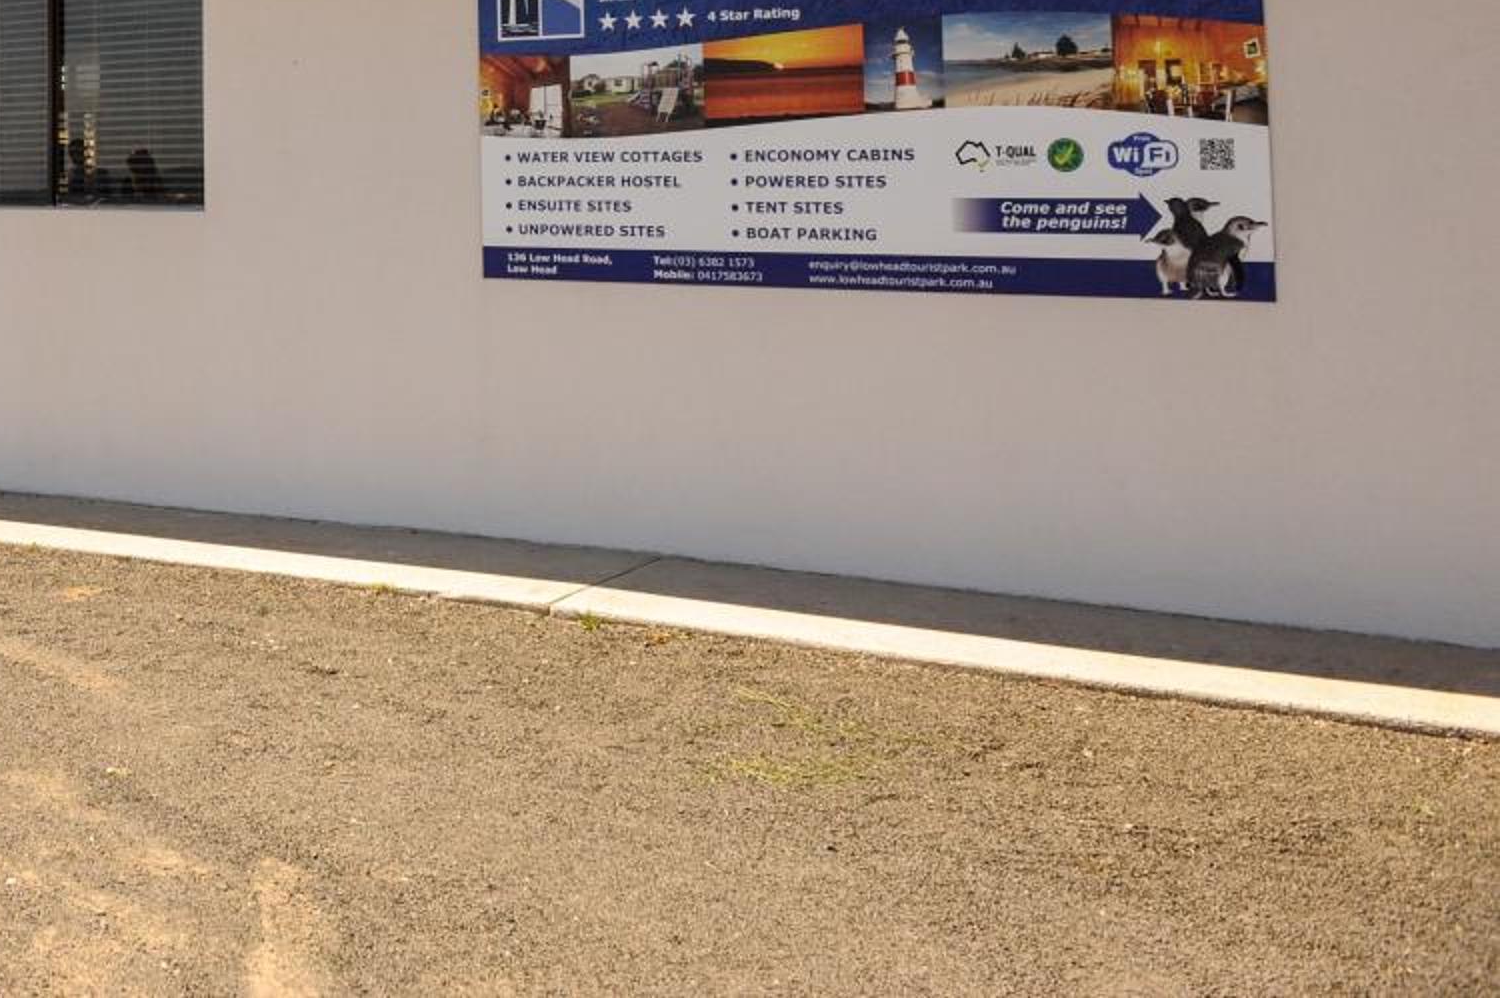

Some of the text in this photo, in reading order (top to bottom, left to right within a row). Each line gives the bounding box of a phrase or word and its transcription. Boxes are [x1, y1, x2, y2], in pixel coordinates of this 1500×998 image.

[707, 6, 801, 22] 4 Star Rating
[517, 150, 703, 163] WATER VIEW COTTAGES
[745, 149, 915, 163] ENCONOMY CABINS
[995, 145, 1036, 159] T-QUAL
[518, 175, 681, 188] BACKPACKER HOSTEL
[745, 175, 887, 188] POWERED SITES
[518, 200, 632, 212] ENSUITE SITES
[746, 201, 843, 215] TENT SITES
[1001, 202, 1127, 214] Come and see
[1002, 216, 1127, 230] the penguins!
[518, 224, 665, 238] UNPOWERED SITES
[746, 227, 877, 241] BOAT PARKING
[508, 253, 612, 266] 136 Low Head Road,
[508, 264, 557, 274] Low Head
[653, 269, 694, 280] Mobile:
[809, 260, 1017, 276] enquiry@lowheadtouristpark.com.au
[809, 275, 994, 289] www.lowheadtouristpark.com.au
